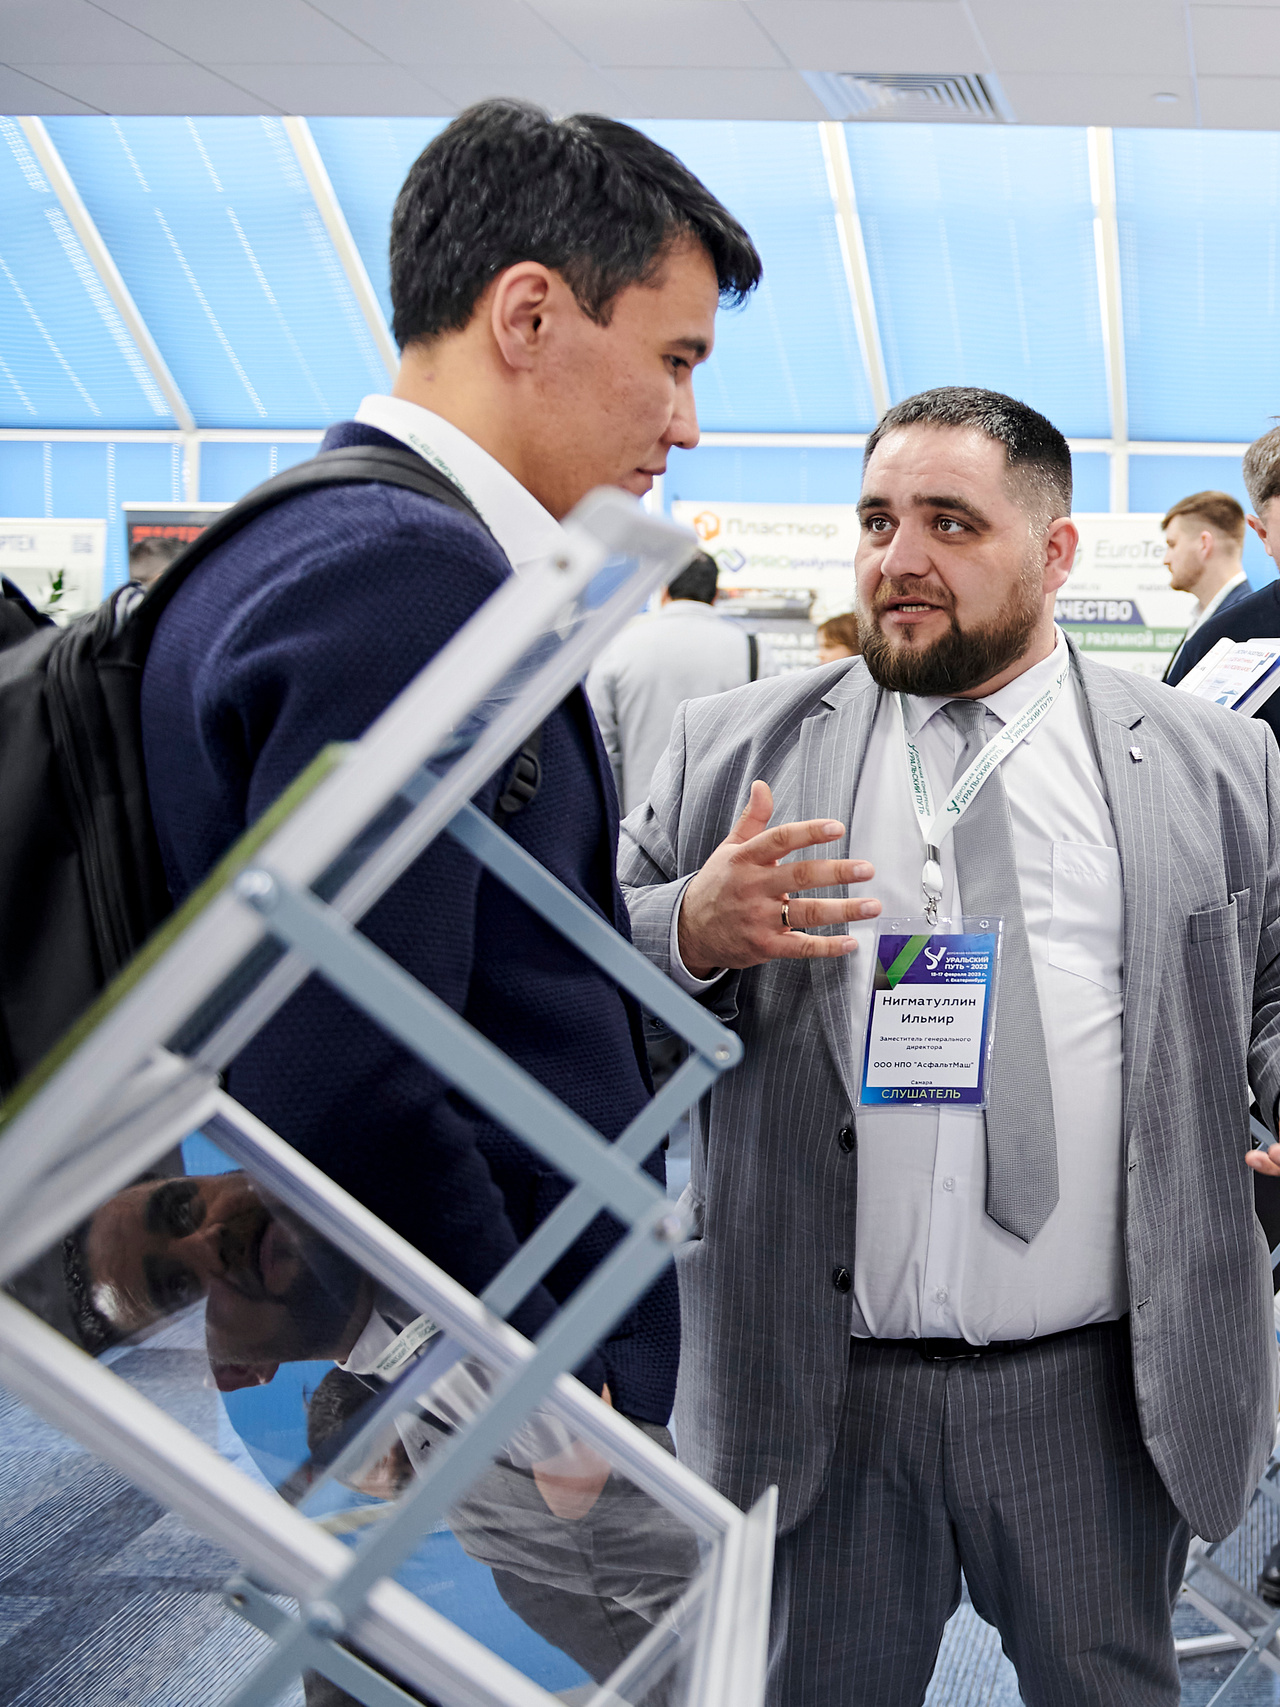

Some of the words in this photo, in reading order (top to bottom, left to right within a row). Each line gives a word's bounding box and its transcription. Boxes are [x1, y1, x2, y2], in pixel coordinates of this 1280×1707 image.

[1094, 539, 1165, 559] EuroTe
[1054, 600, 1133, 621] АЧЕСТВО
[1013, 706, 1041, 739] УРАЛЬСКИЙ
[1039, 696, 1054, 712] ПУТЬ
[908, 750, 922, 795] УРАЛЬСКИЙ
[959, 760, 992, 805] УРАЛЬСКИЙ
[990, 747, 1005, 763] ПУТЬ
[882, 996, 977, 1009] Нигматуллин
[901, 1014, 955, 1025] Ильмир
[881, 1089, 962, 1099] СЛУШАТЕЛЬ
